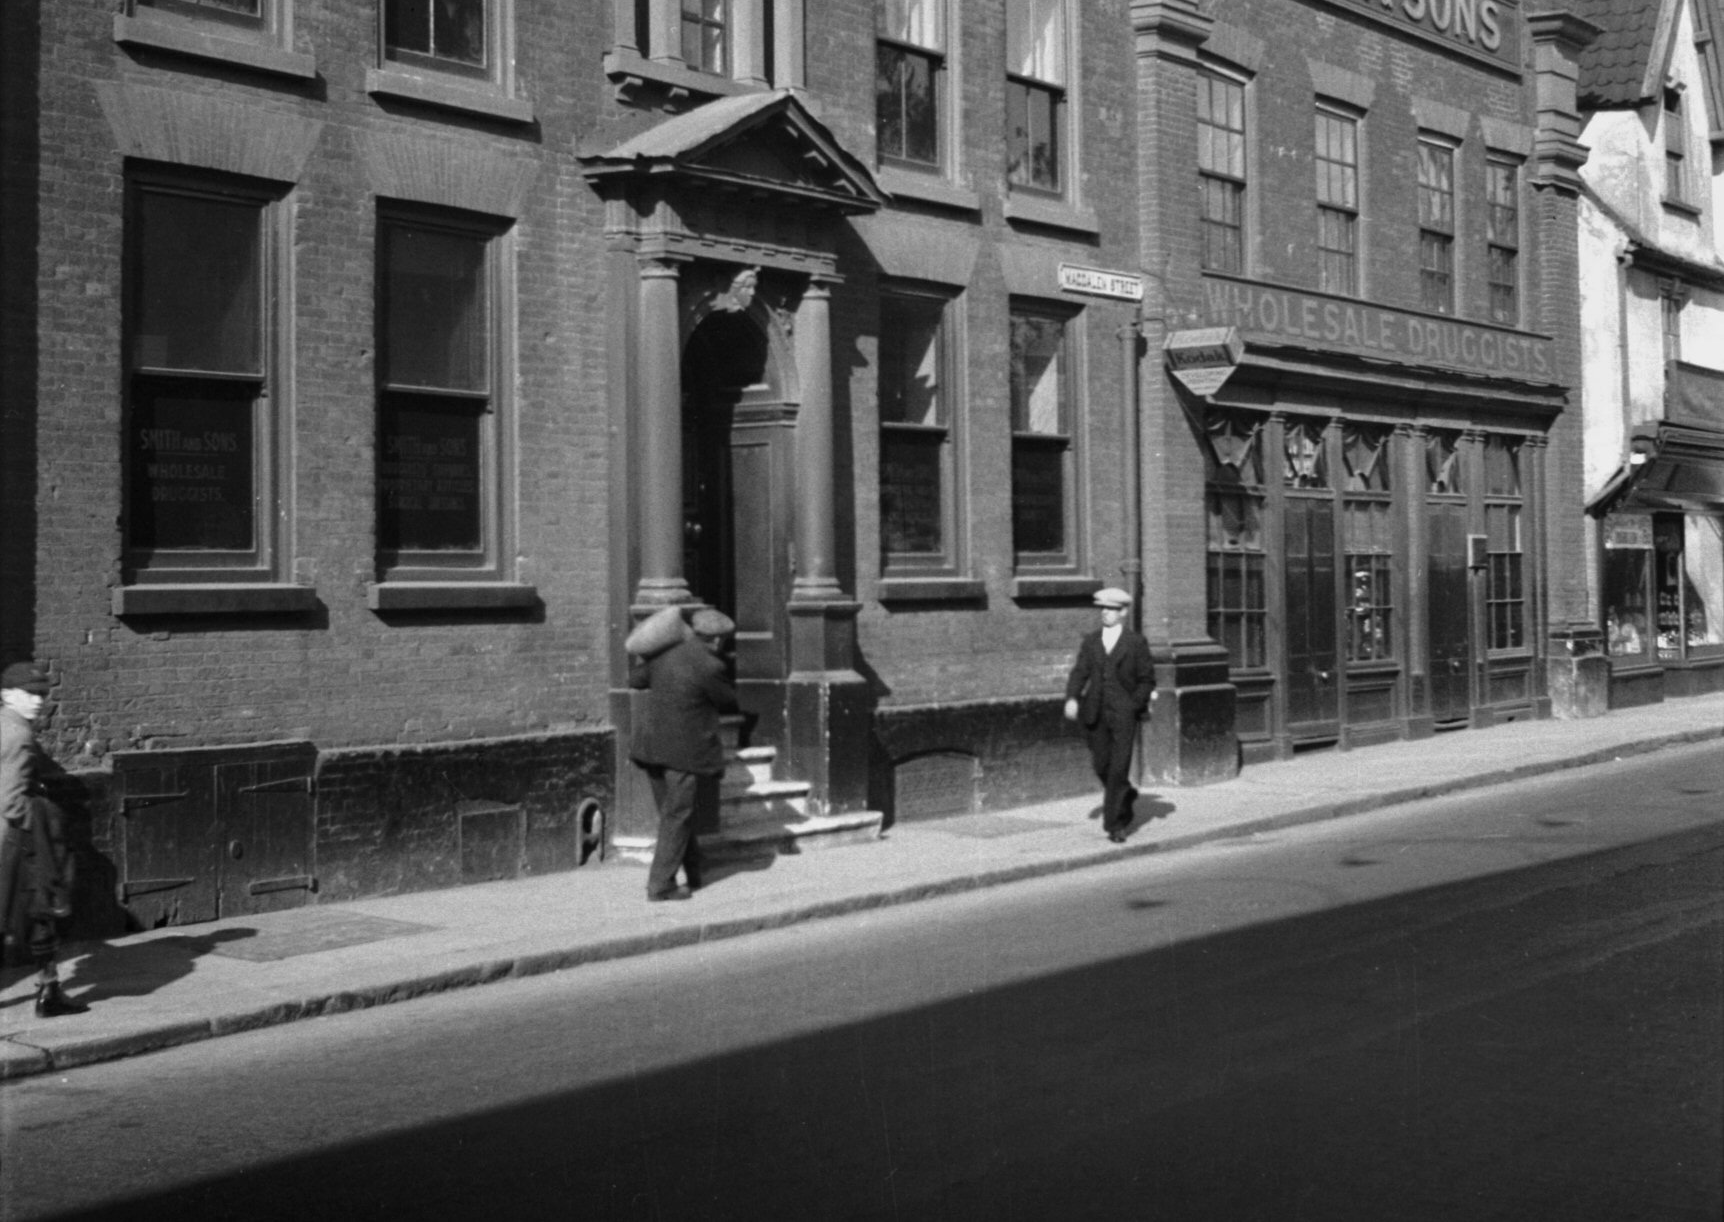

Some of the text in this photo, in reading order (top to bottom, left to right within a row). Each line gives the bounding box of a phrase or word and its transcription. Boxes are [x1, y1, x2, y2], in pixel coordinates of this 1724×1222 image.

[1204, 282, 1396, 351] WHOLESALE
[1175, 349, 1225, 364] Kodak
[139, 428, 181, 451] SMITH
[147, 463, 226, 480] WHOLESALE
